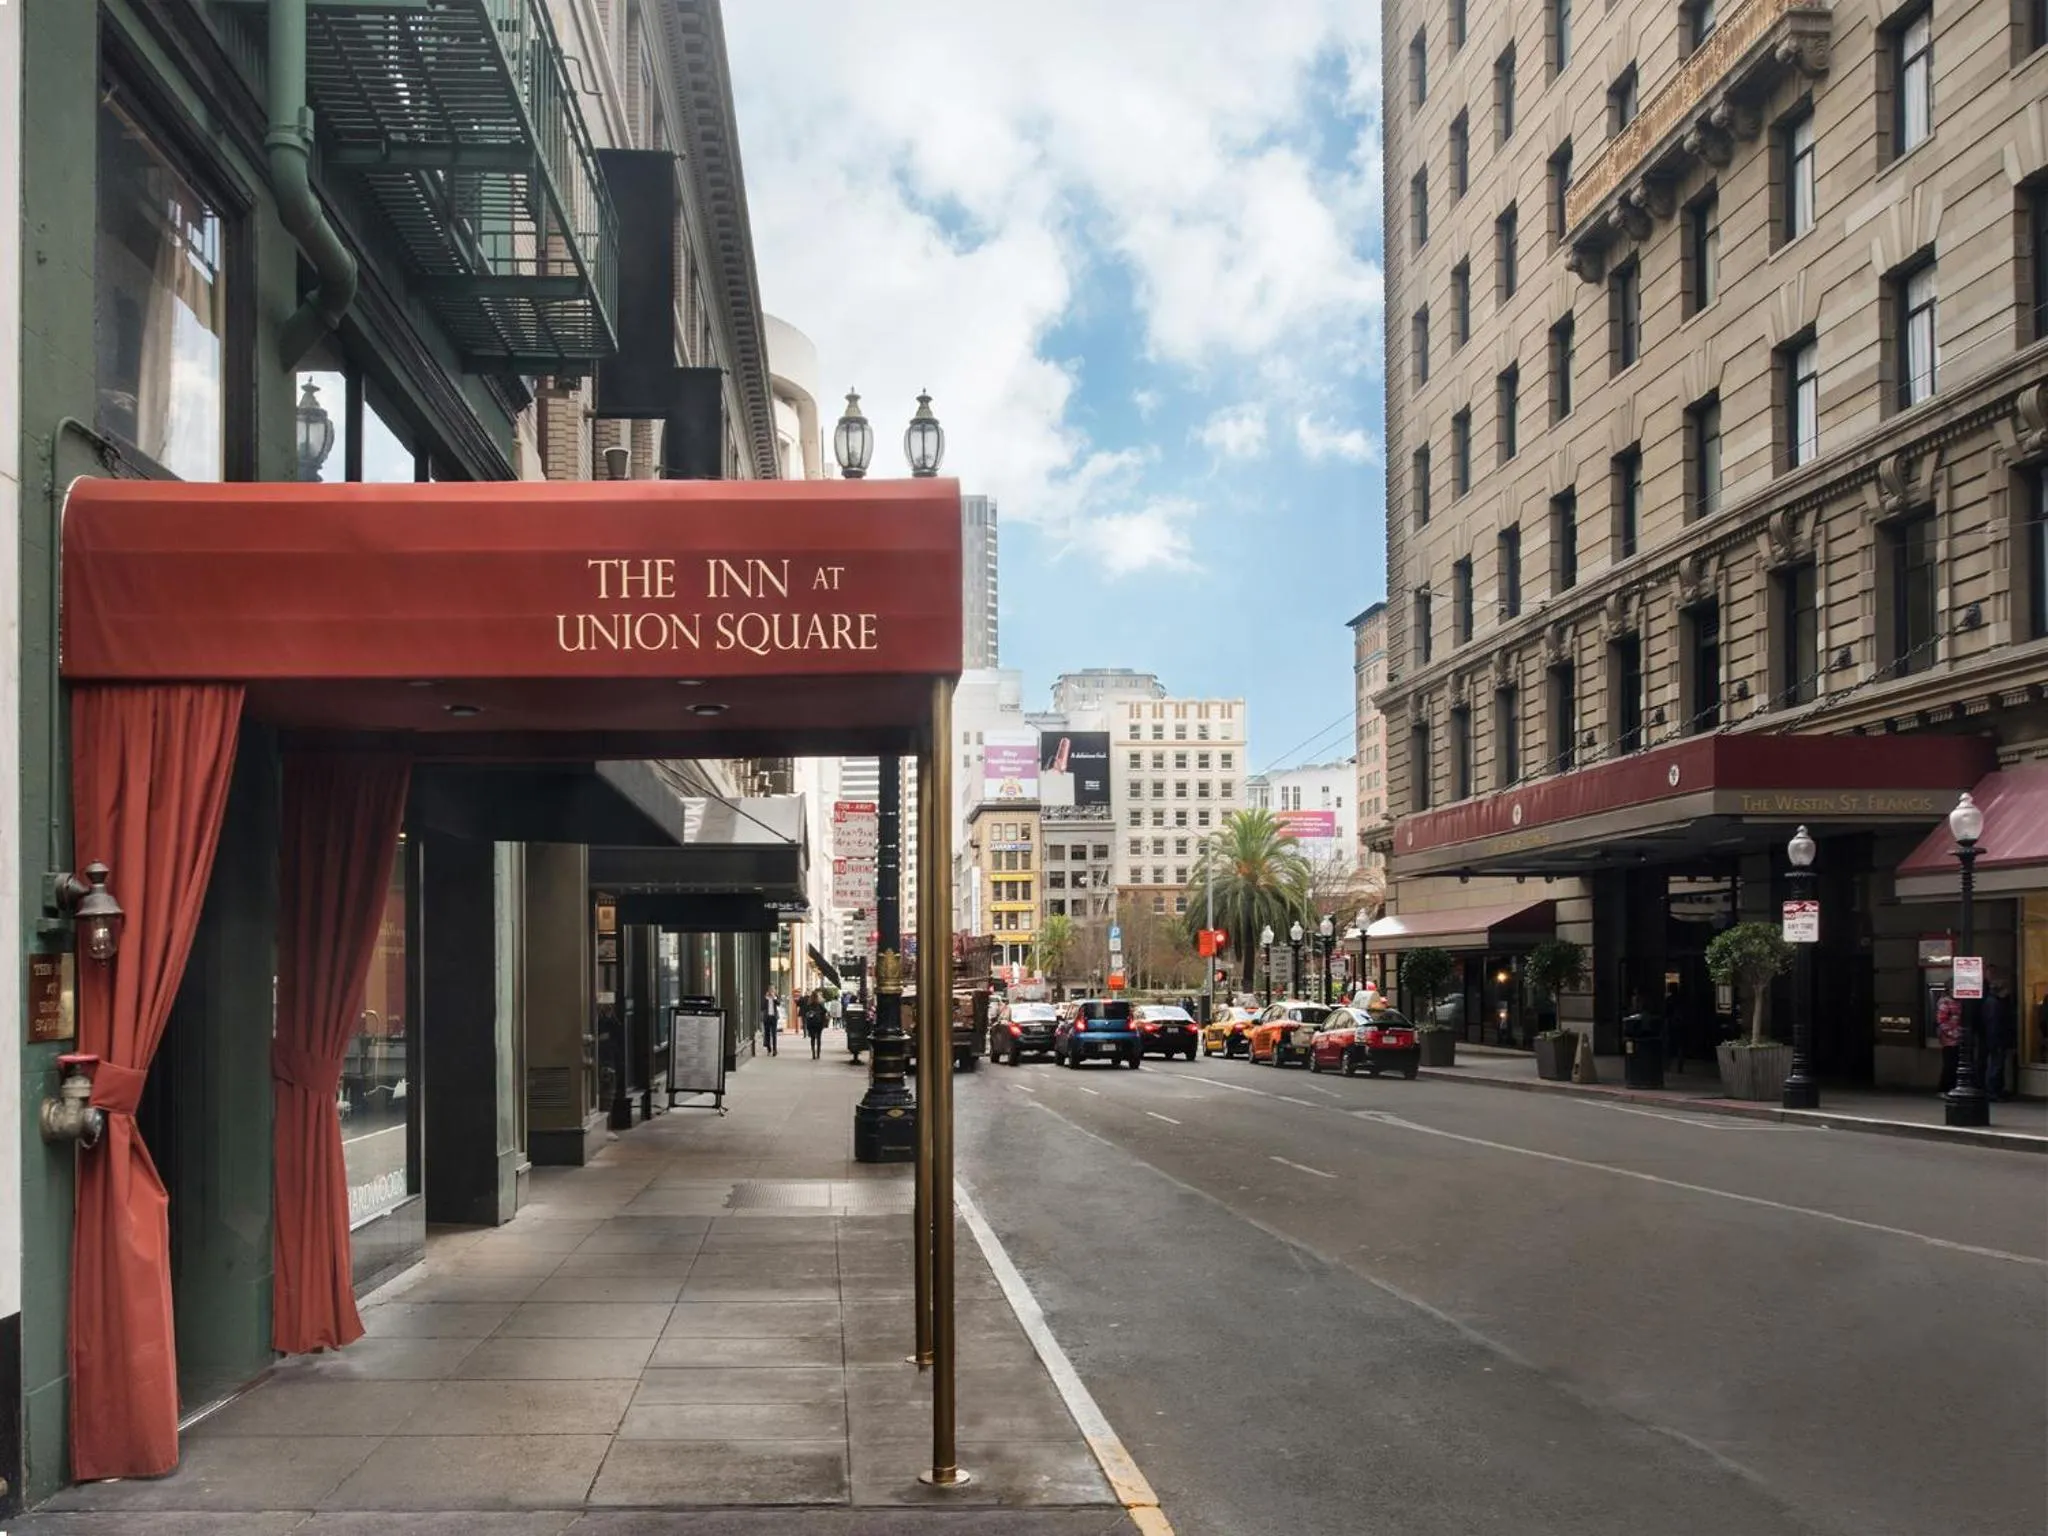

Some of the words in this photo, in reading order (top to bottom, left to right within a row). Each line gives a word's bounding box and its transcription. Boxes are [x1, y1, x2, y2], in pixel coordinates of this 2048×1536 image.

[588, 559, 676, 599] THE
[706, 559, 790, 599] INN
[813, 567, 845, 591] AT
[556, 613, 701, 652] UNION
[716, 612, 878, 656] SQUARE
[1741, 795, 1770, 811] THE
[1774, 795, 1834, 811] WESTIN
[1868, 794, 1934, 811] FRANCIS
